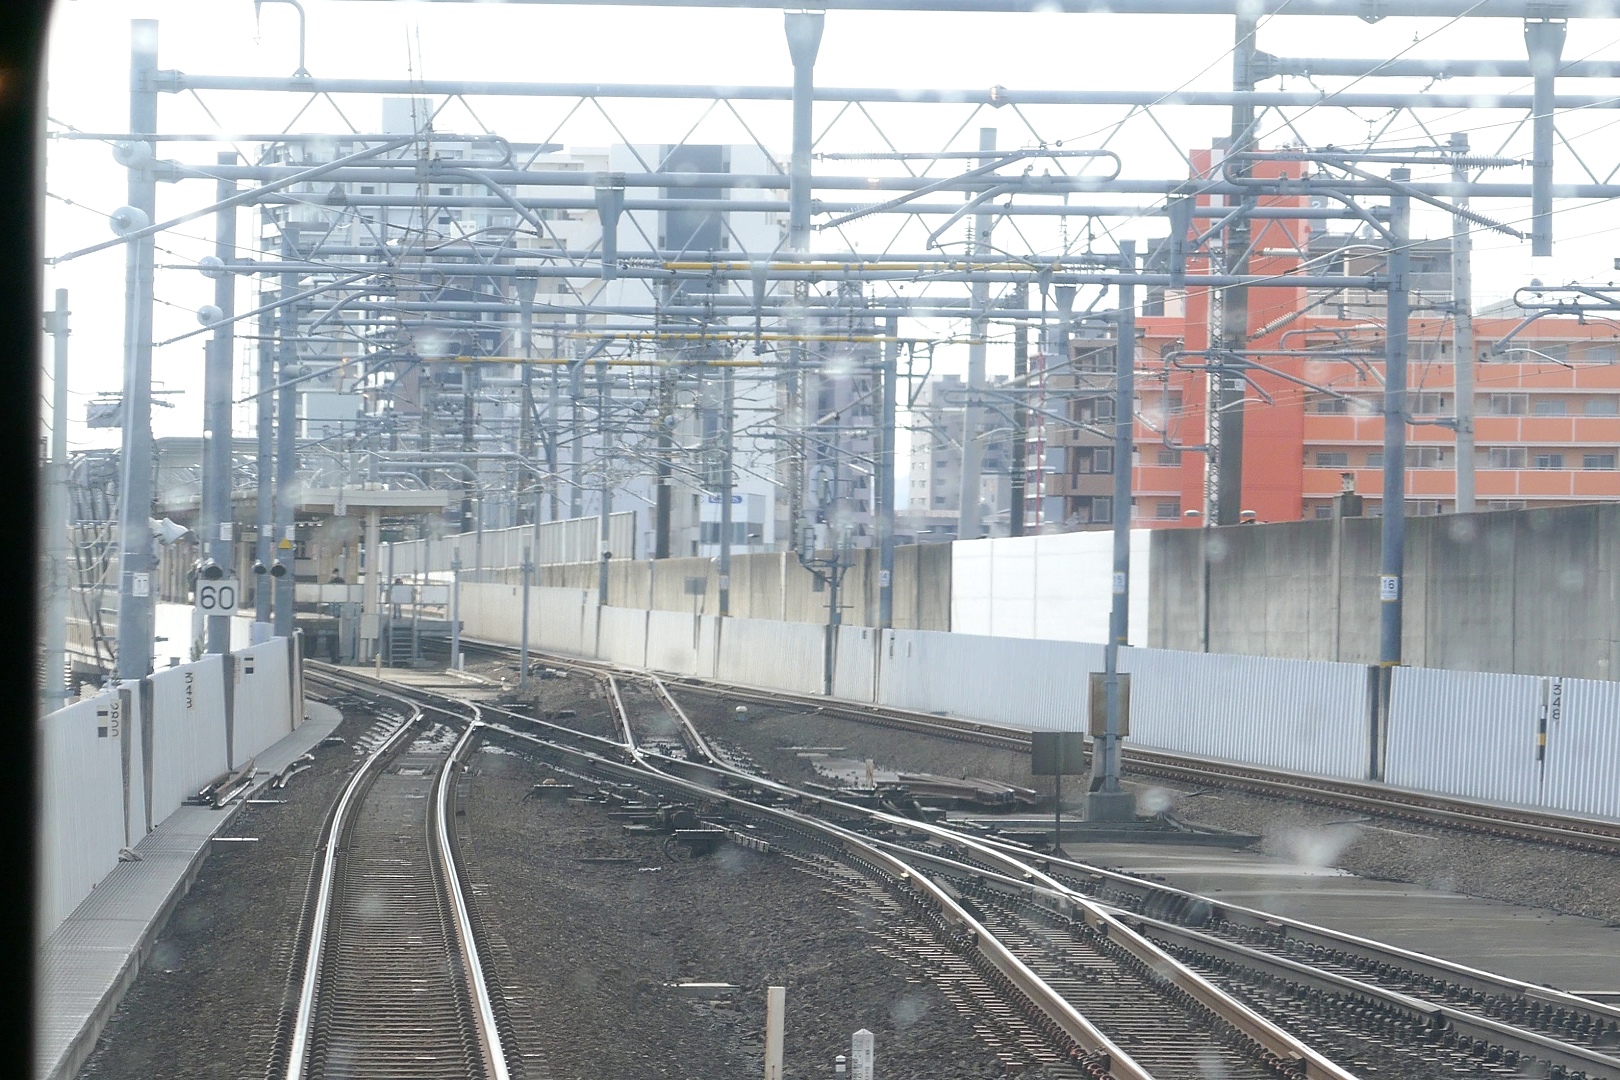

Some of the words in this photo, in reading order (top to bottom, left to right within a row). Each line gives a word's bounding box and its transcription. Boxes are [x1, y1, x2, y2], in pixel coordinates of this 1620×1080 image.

[1383, 579, 1395, 590] 16
[200, 585, 235, 610] 60
[1552, 684, 1562, 720] 348
